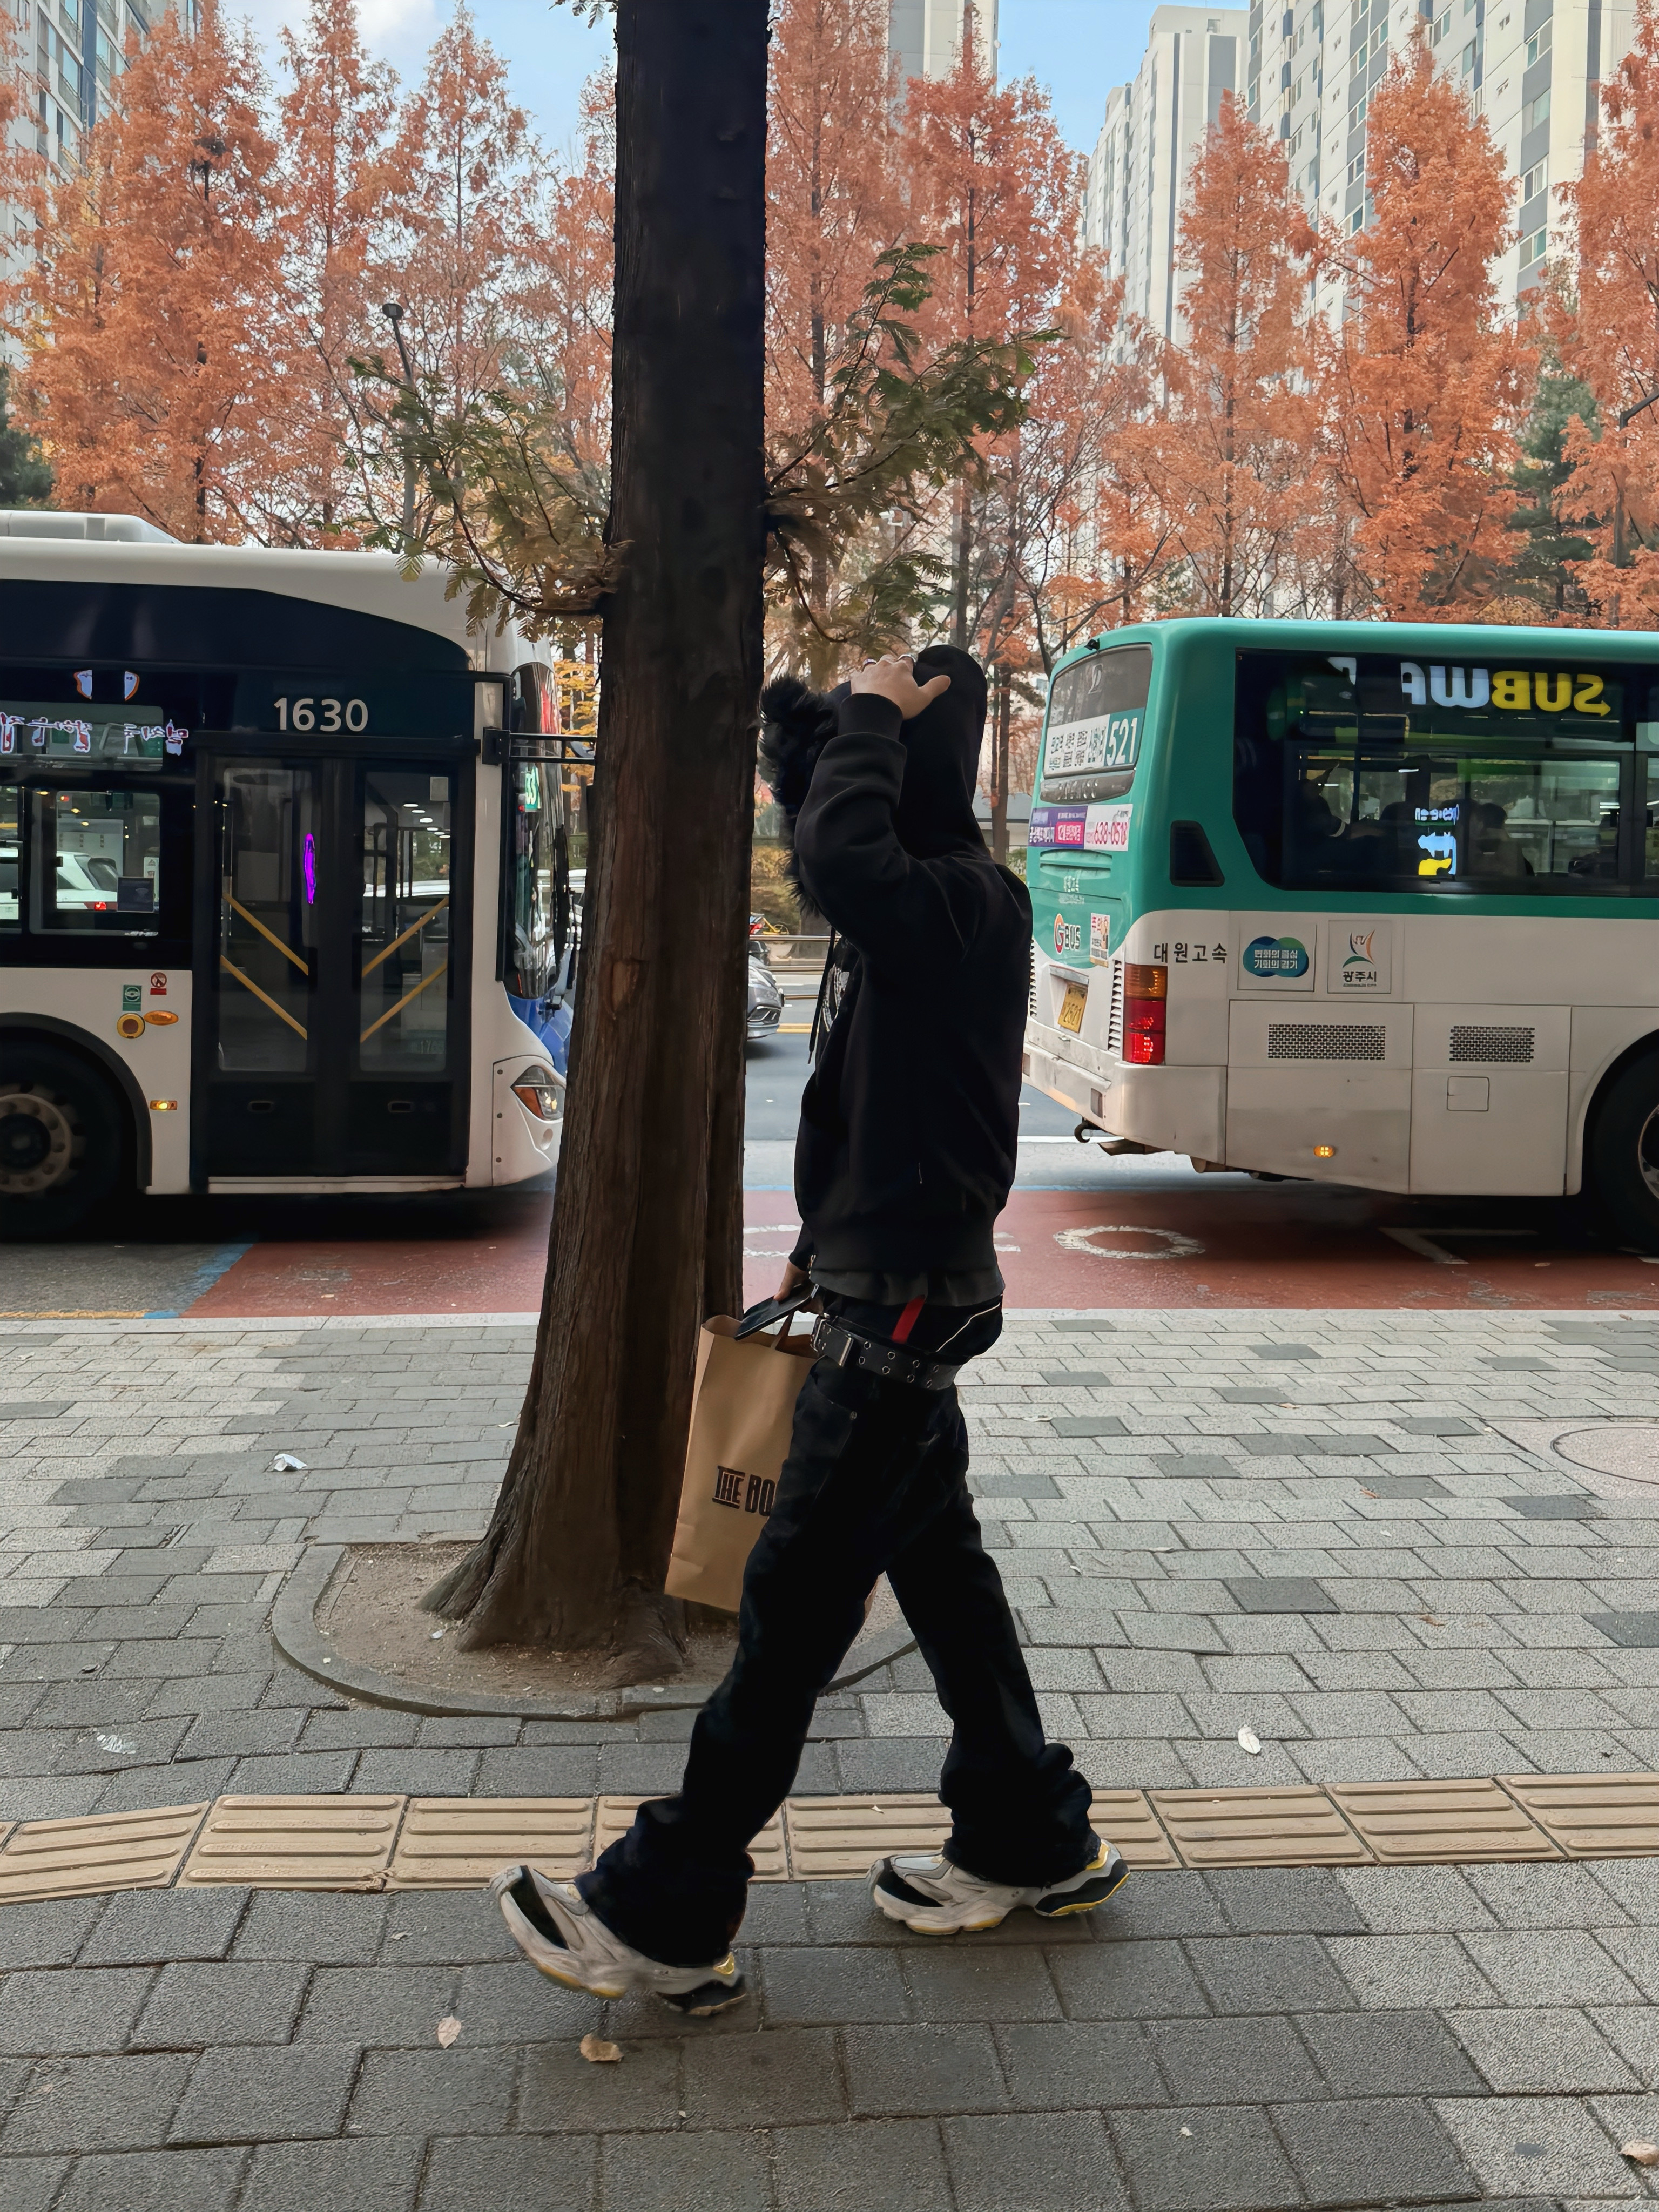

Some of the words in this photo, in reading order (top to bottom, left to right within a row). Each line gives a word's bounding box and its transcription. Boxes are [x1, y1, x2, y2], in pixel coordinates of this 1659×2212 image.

[274, 698, 368, 732] 1630
[1106, 717, 1138, 766] 521
[1154, 942, 1227, 964] 대원고속
[1343, 971, 1377, 982] 광주시
[712, 1465, 745, 1509] THE
